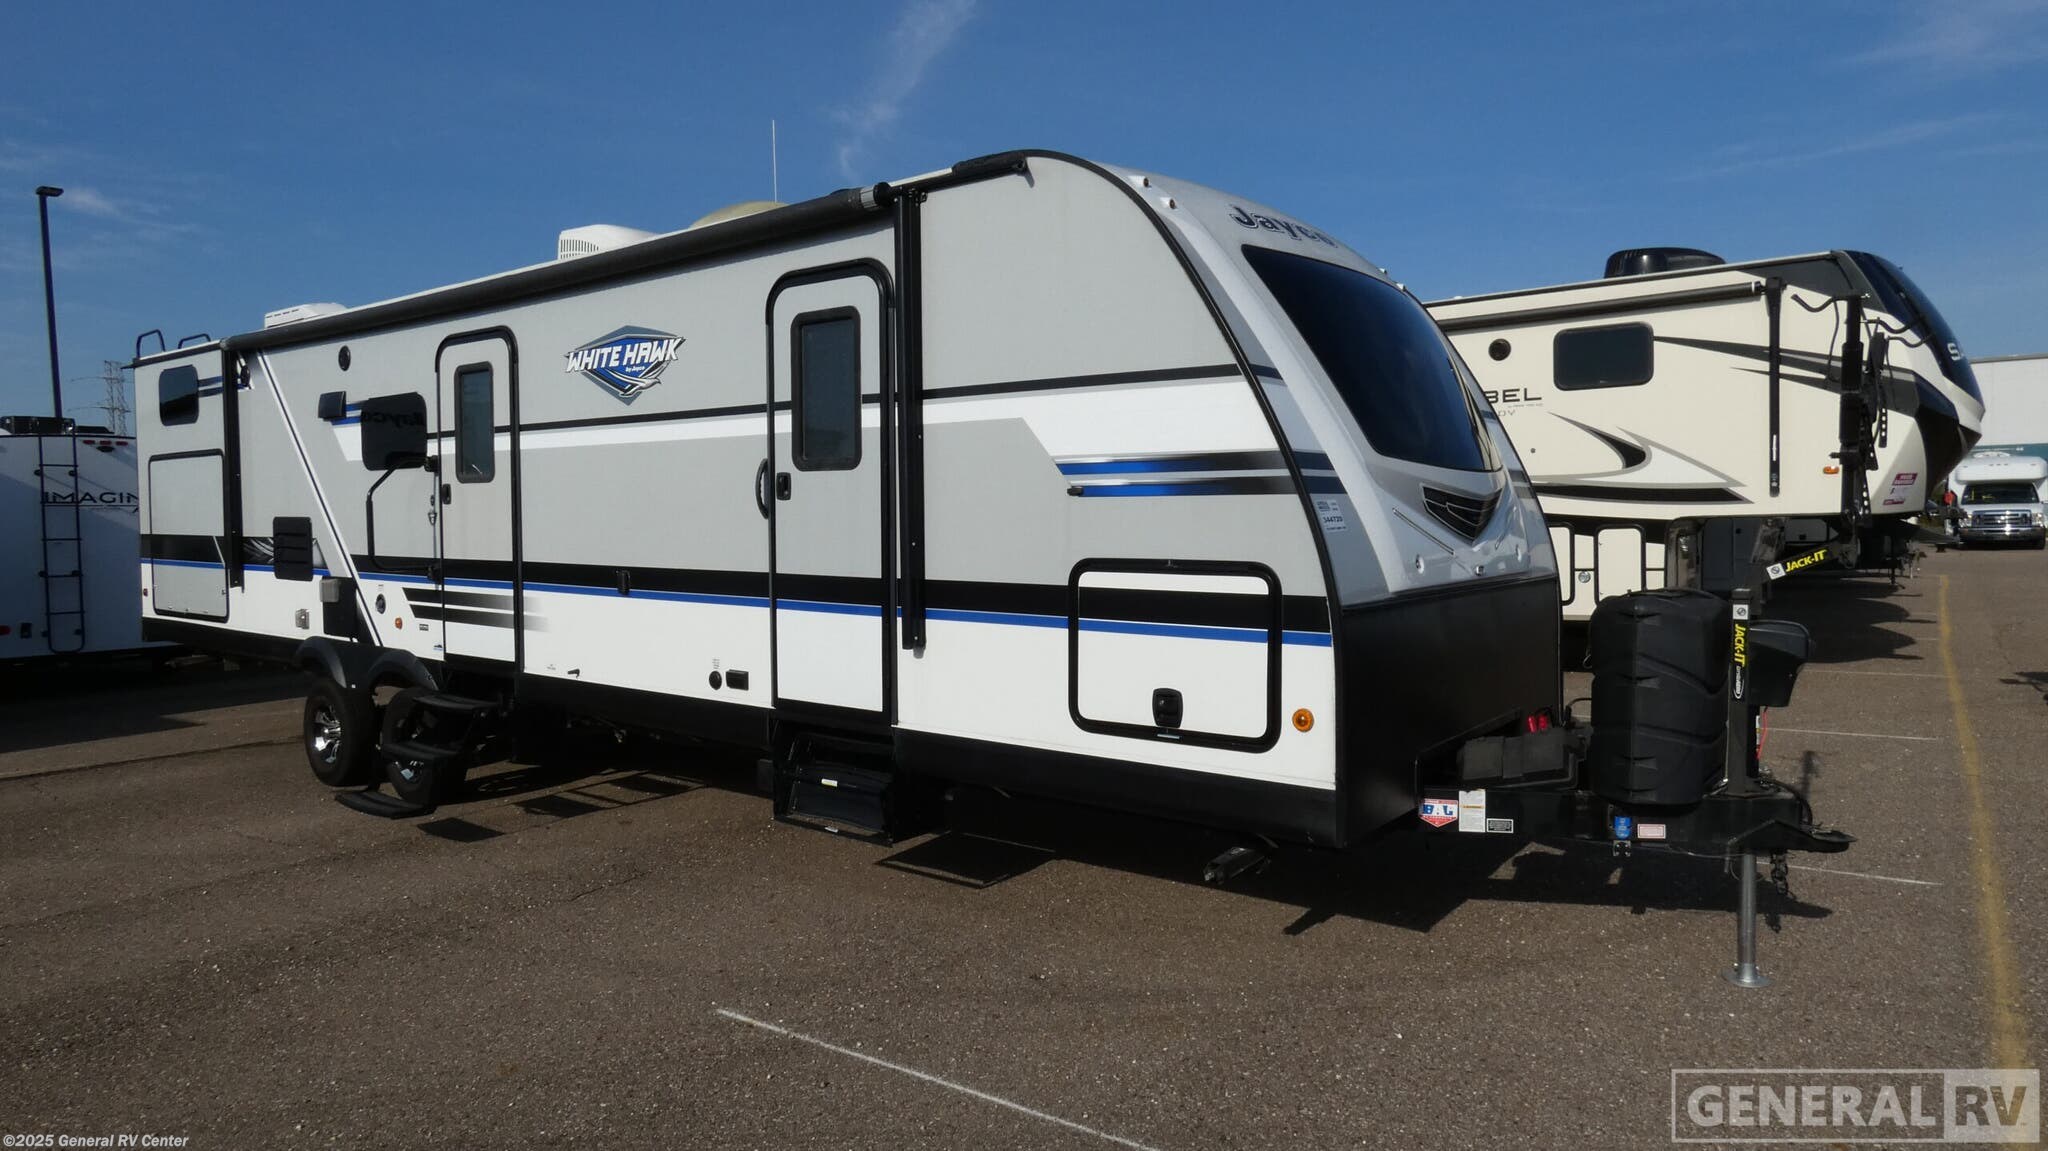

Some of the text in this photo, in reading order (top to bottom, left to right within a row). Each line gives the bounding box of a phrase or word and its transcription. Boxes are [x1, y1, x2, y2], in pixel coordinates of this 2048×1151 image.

[1229, 204, 1338, 248] Jayco
[565, 337, 686, 373] WHITE HAWK
[1484, 387, 1542, 404] BEL
[1785, 549, 1828, 573] JACK-IT
[1734, 623, 1747, 668] JACK-IT
